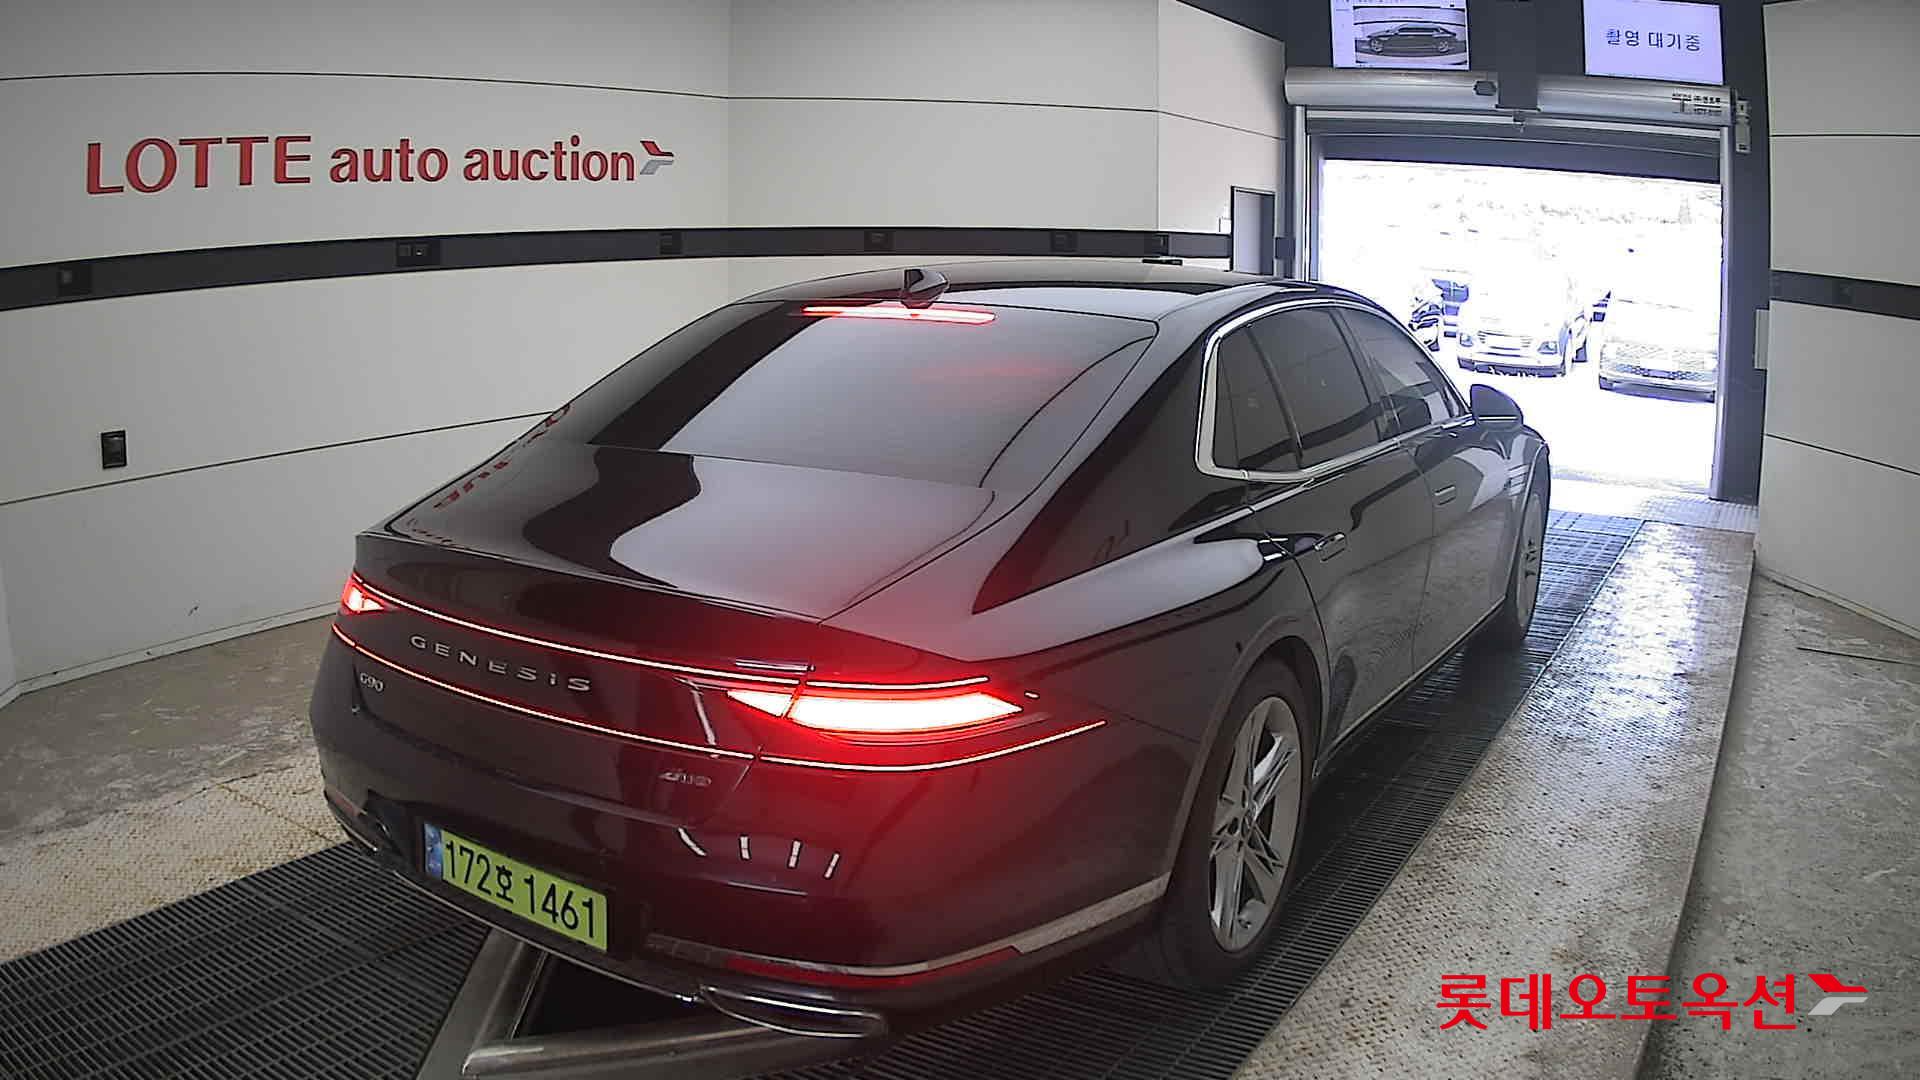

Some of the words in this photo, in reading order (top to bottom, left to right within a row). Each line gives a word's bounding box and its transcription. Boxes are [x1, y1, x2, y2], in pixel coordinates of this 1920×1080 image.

[1607, 28, 1639, 47] 촬영
[1648, 31, 1700, 52] 대기중
[86, 135, 311, 194] LOTTE
[329, 138, 449, 183] auto
[463, 134, 635, 182] auction
[410, 634, 592, 692] GENESIS
[446, 840, 514, 904] 172호
[524, 874, 594, 938] 1461
